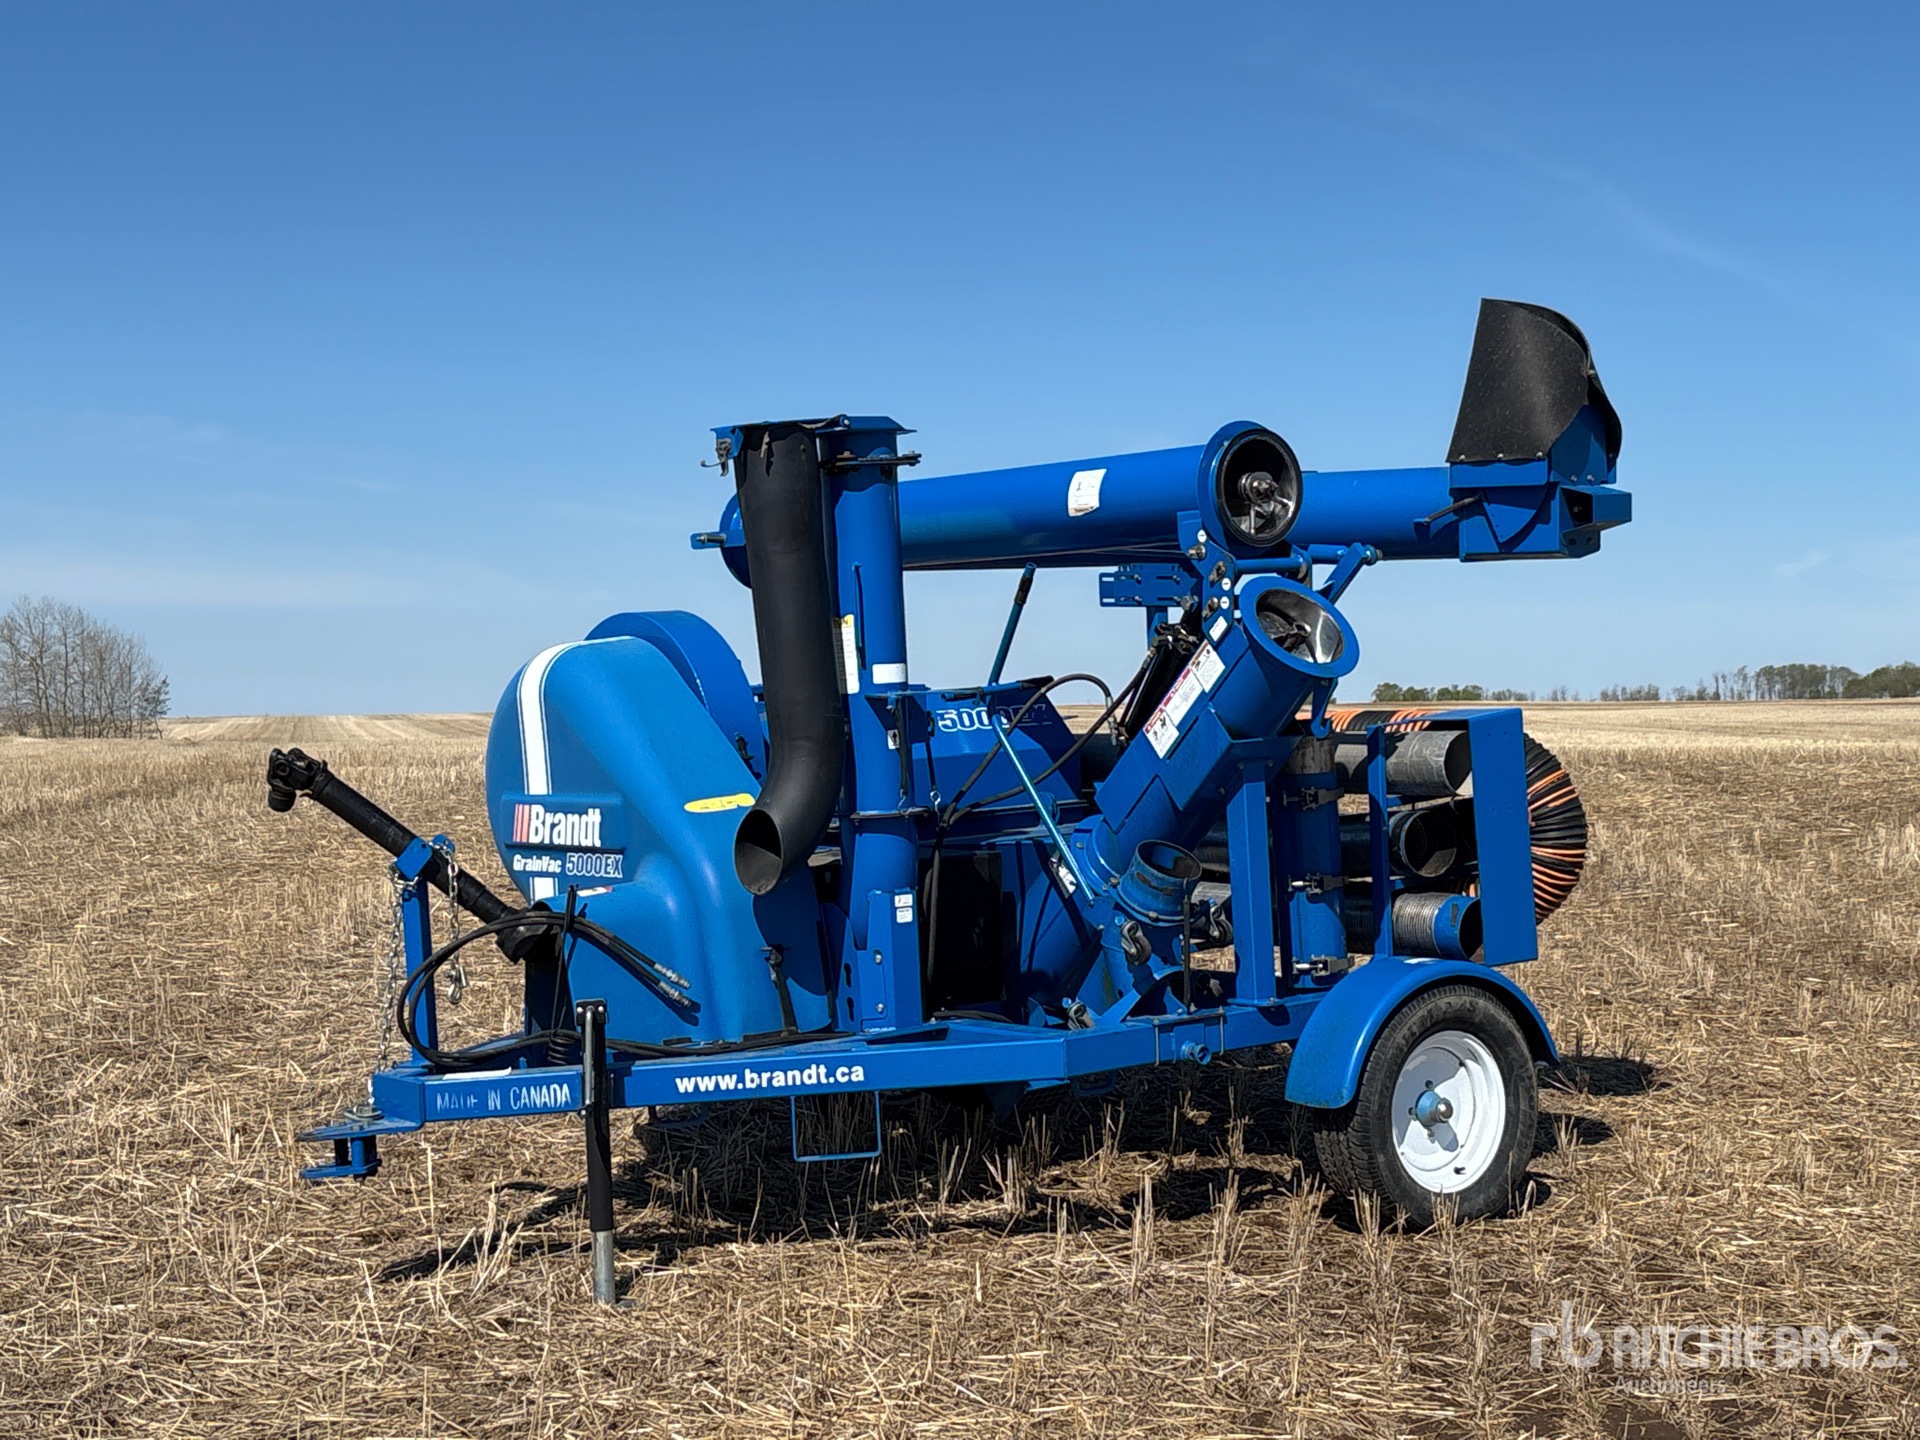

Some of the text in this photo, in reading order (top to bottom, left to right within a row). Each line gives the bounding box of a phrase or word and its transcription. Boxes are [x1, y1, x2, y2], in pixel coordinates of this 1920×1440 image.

[529, 804, 602, 847] Brandt
[513, 852, 624, 879] GrainVac 5000EX
[675, 1064, 865, 1093] www.brandt.ca
[488, 1089, 501, 1111] IN
[510, 1083, 572, 1110] CANADA
